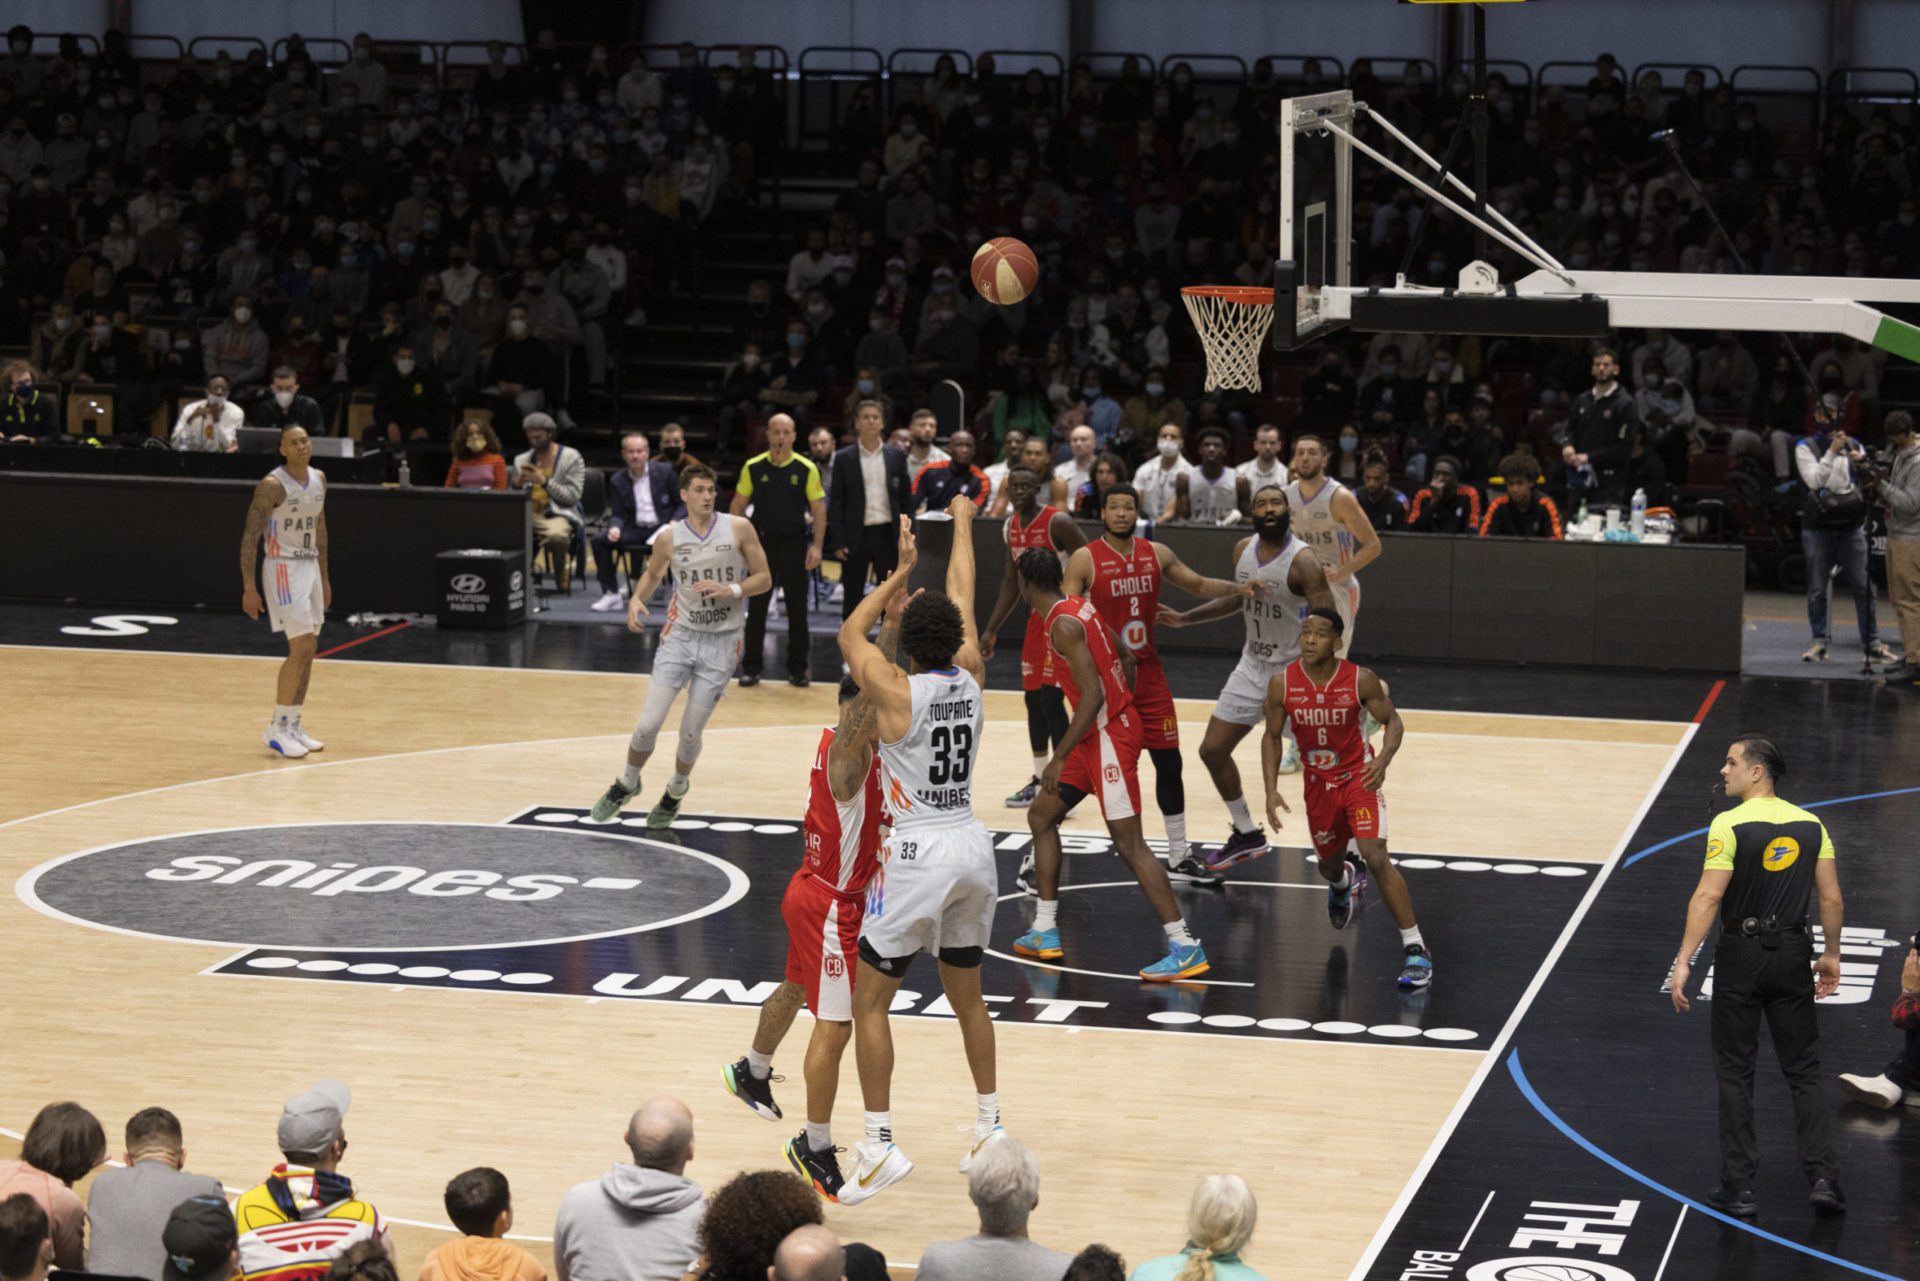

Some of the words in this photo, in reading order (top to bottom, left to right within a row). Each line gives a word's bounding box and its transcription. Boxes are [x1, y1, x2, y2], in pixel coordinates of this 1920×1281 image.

[304, 533, 311, 549] 0
[679, 566, 734, 586] PARIS
[1110, 575, 1153, 597] CHOLET
[1130, 597, 1139, 616] 2
[1245, 598, 1282, 619] ARIS
[61, 615, 178, 636] S
[1253, 619, 1261, 639] 1
[930, 700, 973, 722] TOUPANE
[1294, 707, 1348, 726] CHOLET
[1318, 728, 1327, 745] 6
[929, 724, 972, 785] 33
[917, 786, 970, 804] UNIBE
[901, 842, 917, 860] 33
[145, 855, 579, 900] snipes
[826, 959, 842, 975] CB
[593, 973, 1109, 1022] UNET
[1509, 1199, 1641, 1256] THE
